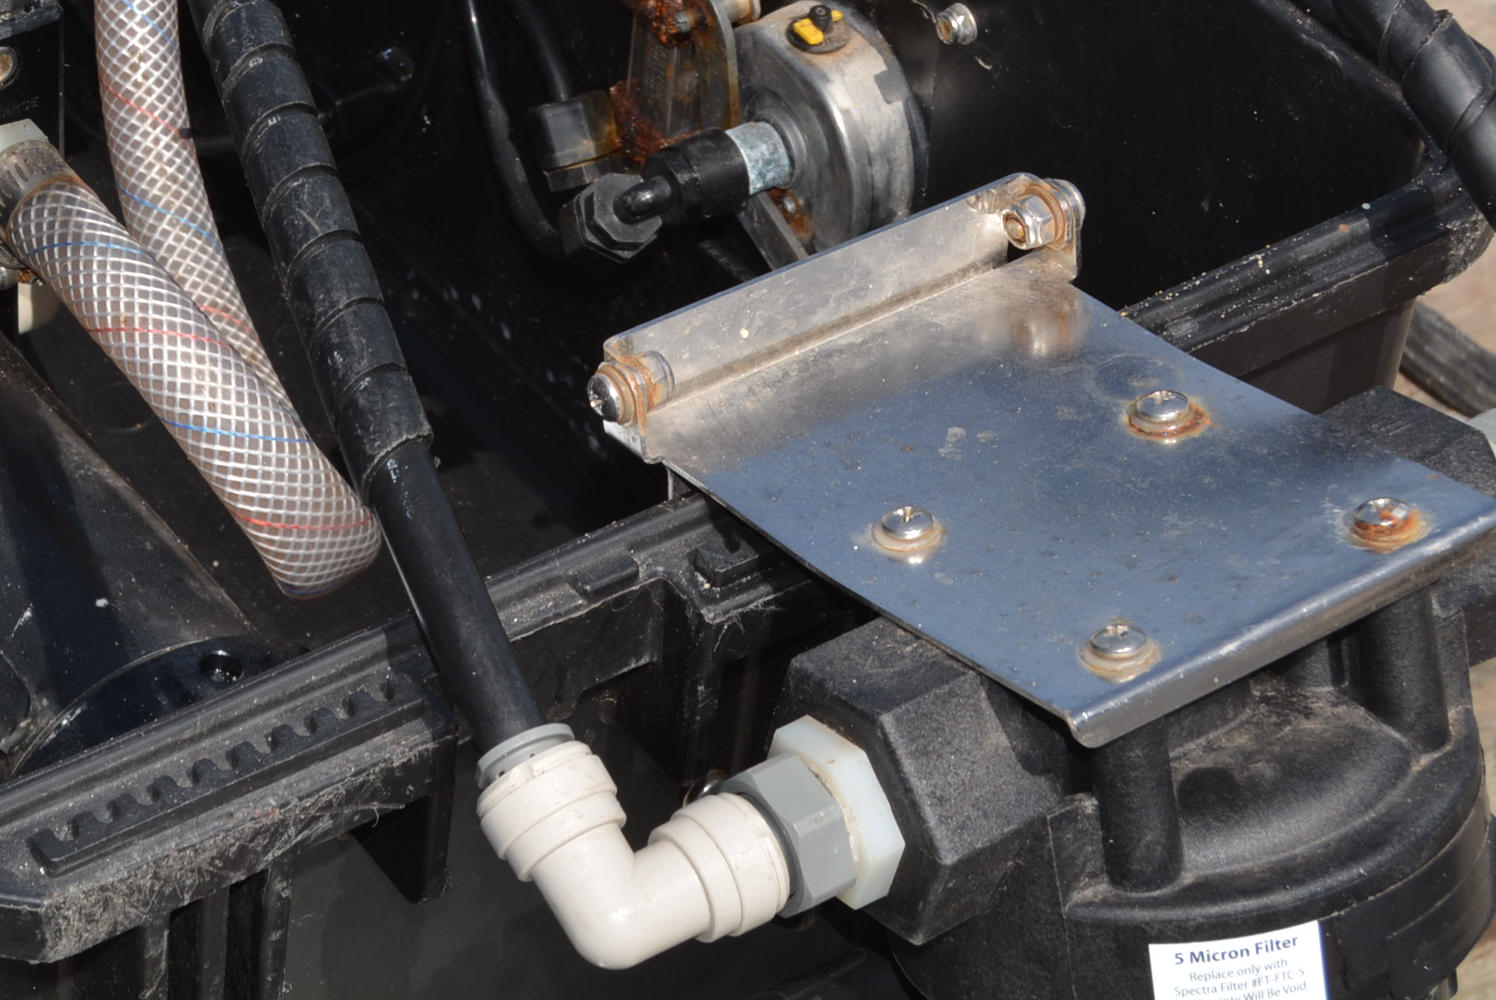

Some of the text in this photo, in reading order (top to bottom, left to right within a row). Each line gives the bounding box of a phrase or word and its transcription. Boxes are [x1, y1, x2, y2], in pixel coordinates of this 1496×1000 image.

[1174, 936, 1298, 965] 5 Micron Filter
[1189, 958, 1288, 983] Replace only with
[1174, 985, 1217, 998] Spectra
[1220, 980, 1248, 993] Filter
[1244, 989, 1264, 1000] Will
[1267, 987, 1281, 998] Be
[1282, 980, 1307, 993] Void
